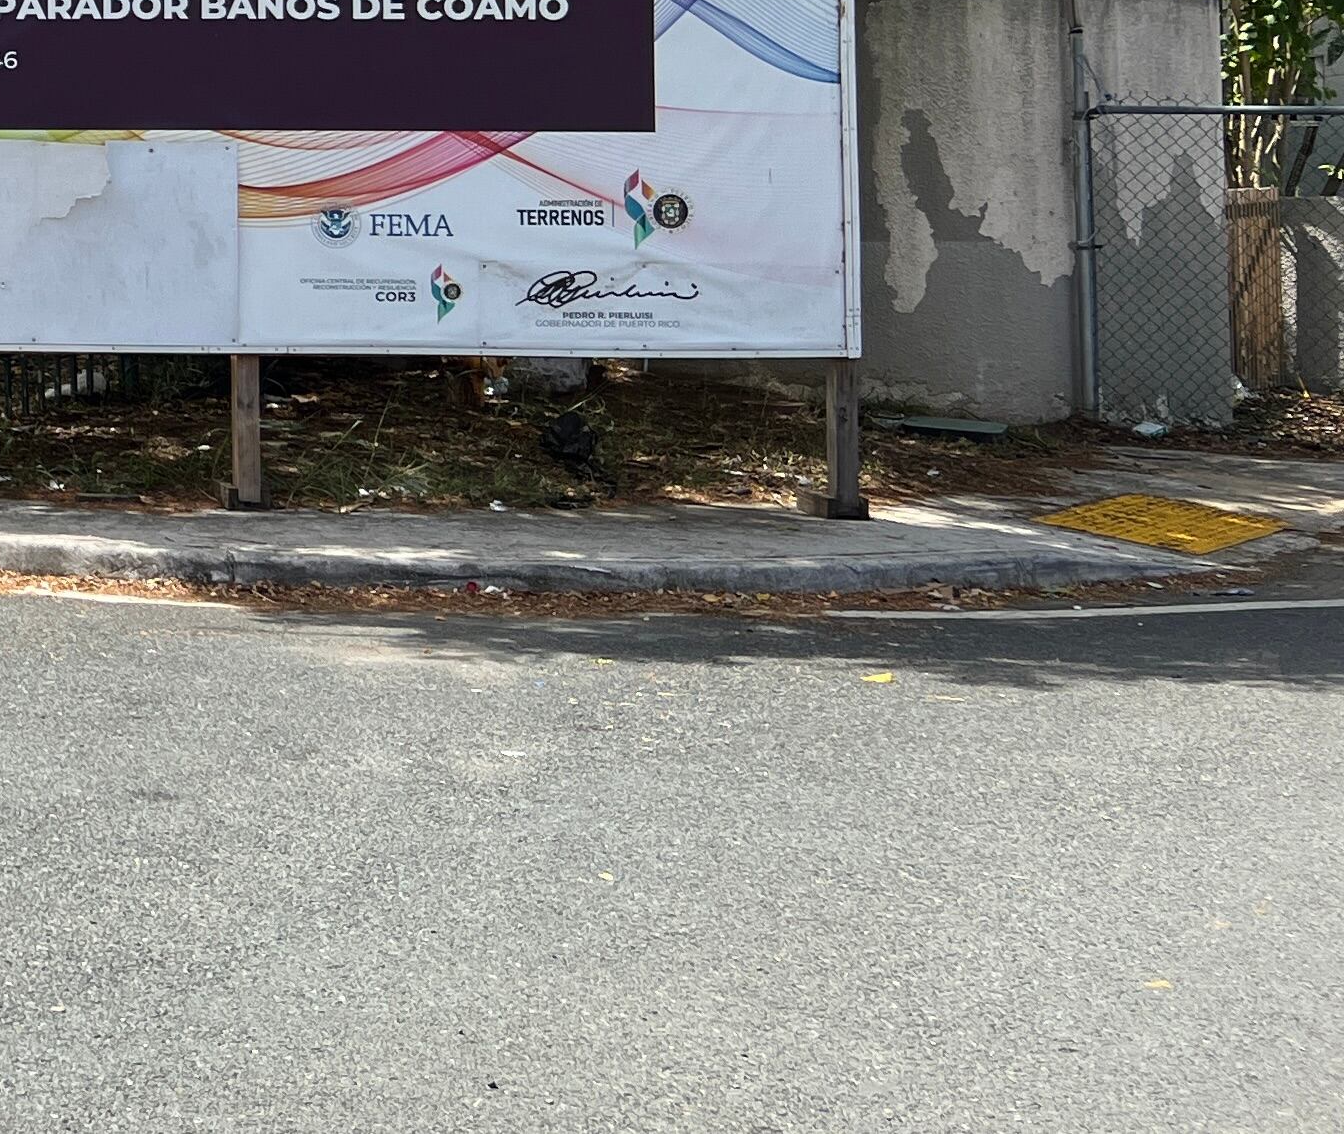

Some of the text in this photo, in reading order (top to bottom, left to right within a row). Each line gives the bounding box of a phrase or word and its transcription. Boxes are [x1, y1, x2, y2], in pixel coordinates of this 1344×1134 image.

[516, 209, 605, 226] TERRENOS
[369, 213, 454, 237] FEMA
[375, 291, 416, 302] COR3
[562, 312, 654, 320] PEDRO R. PIERLUISI
[535, 320, 681, 328] GOBERNADOR DE PUERTO RICO
